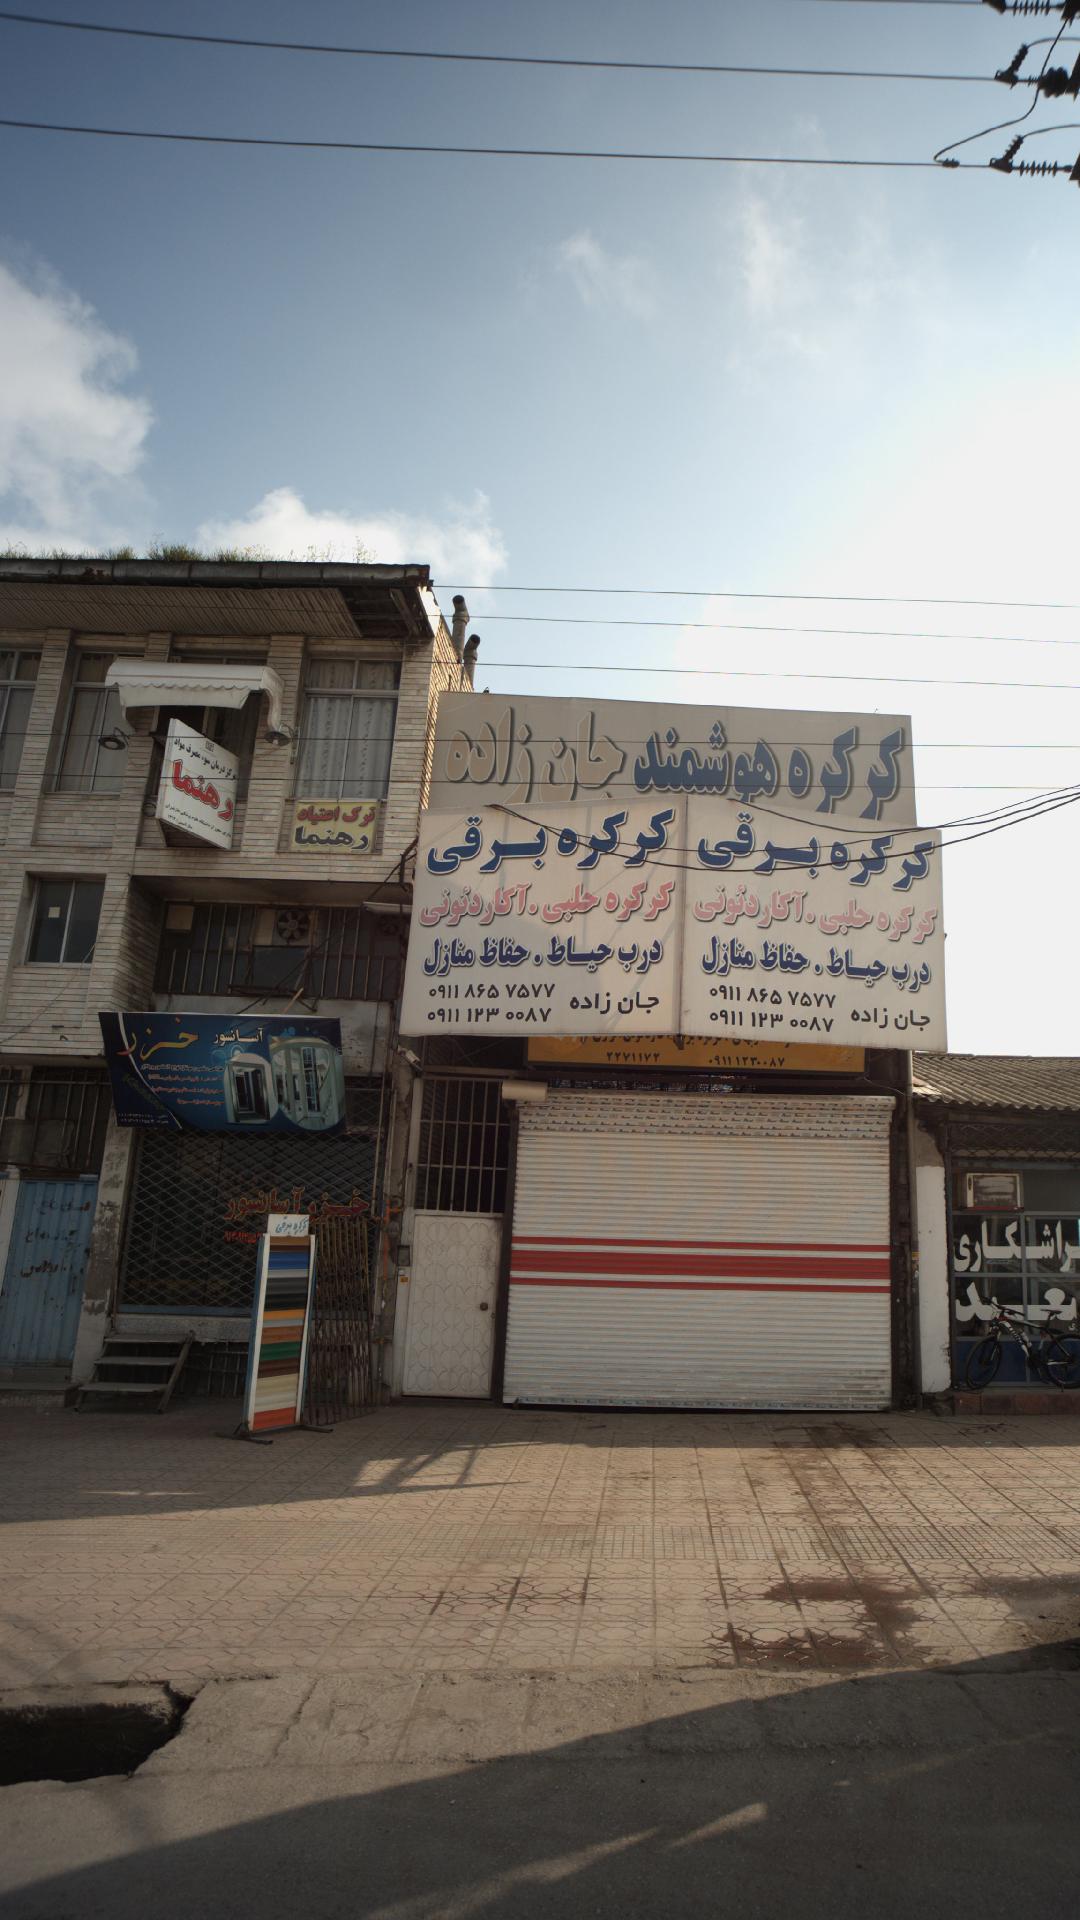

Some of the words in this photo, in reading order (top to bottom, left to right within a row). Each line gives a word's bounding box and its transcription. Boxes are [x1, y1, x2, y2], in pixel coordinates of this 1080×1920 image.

[446, 707, 531, 804] زاده
[540, 711, 626, 801] جان
[634, 720, 778, 802] هوشمند
[788, 726, 904, 821] کرکره
[173, 759, 234, 821] رهنما
[297, 805, 340, 825] اعتیاد
[342, 806, 376, 827] ترک
[296, 826, 369, 849] رهنما
[426, 816, 548, 875] برقی
[557, 808, 675, 869] کرکره
[697, 811, 819, 878] برقی
[830, 835, 934, 890] کرکره
[419, 882, 533, 926] آکاردئونی
[541, 883, 600, 923] حلبی
[604, 880, 675, 922] کرکره
[693, 884, 807, 928] آکاردئونی
[818, 898, 874, 935] حلبی
[876, 904, 937, 943] کرکره
[423, 936, 475, 976] منازل
[479, 936, 530, 967] حفاظ
[547, 935, 614, 972] حیاط
[617, 938, 664, 973] درب
[701, 935, 755, 976] منازل
[759, 939, 810, 973] حفاظ
[826, 946, 888, 986] حیاط
[429, 984, 459, 999] ۰۹۱۱
[464, 983, 500, 999] ۸۶۵
[505, 983, 556, 999] ۷۵۷۷
[709, 984, 741, 1001] ۰۹۱۱
[747, 987, 783, 1005] ۸۶۵
[788, 990, 836, 1008] ۷۵۷۷
[891, 962, 932, 992] درب
[427, 1008, 460, 1023] ۰۹۱۱
[466, 1007, 500, 1023] ۱۲۳
[505, 1007, 552, 1023] ۰۰۸۷
[569, 992, 611, 1014] زاده
[617, 992, 660, 1014] جان
[709, 1009, 743, 1026] ۰۹۱۱
[751, 1011, 784, 1028] ۱۲۳
[789, 1016, 834, 1032] ۰۰۸۷
[850, 1007, 888, 1029] زاده
[893, 1009, 931, 1031] جان
[116, 1017, 199, 1061] خزر
[213, 1027, 264, 1048] آسانسور
[953, 1220, 1080, 1272] راشکاری
